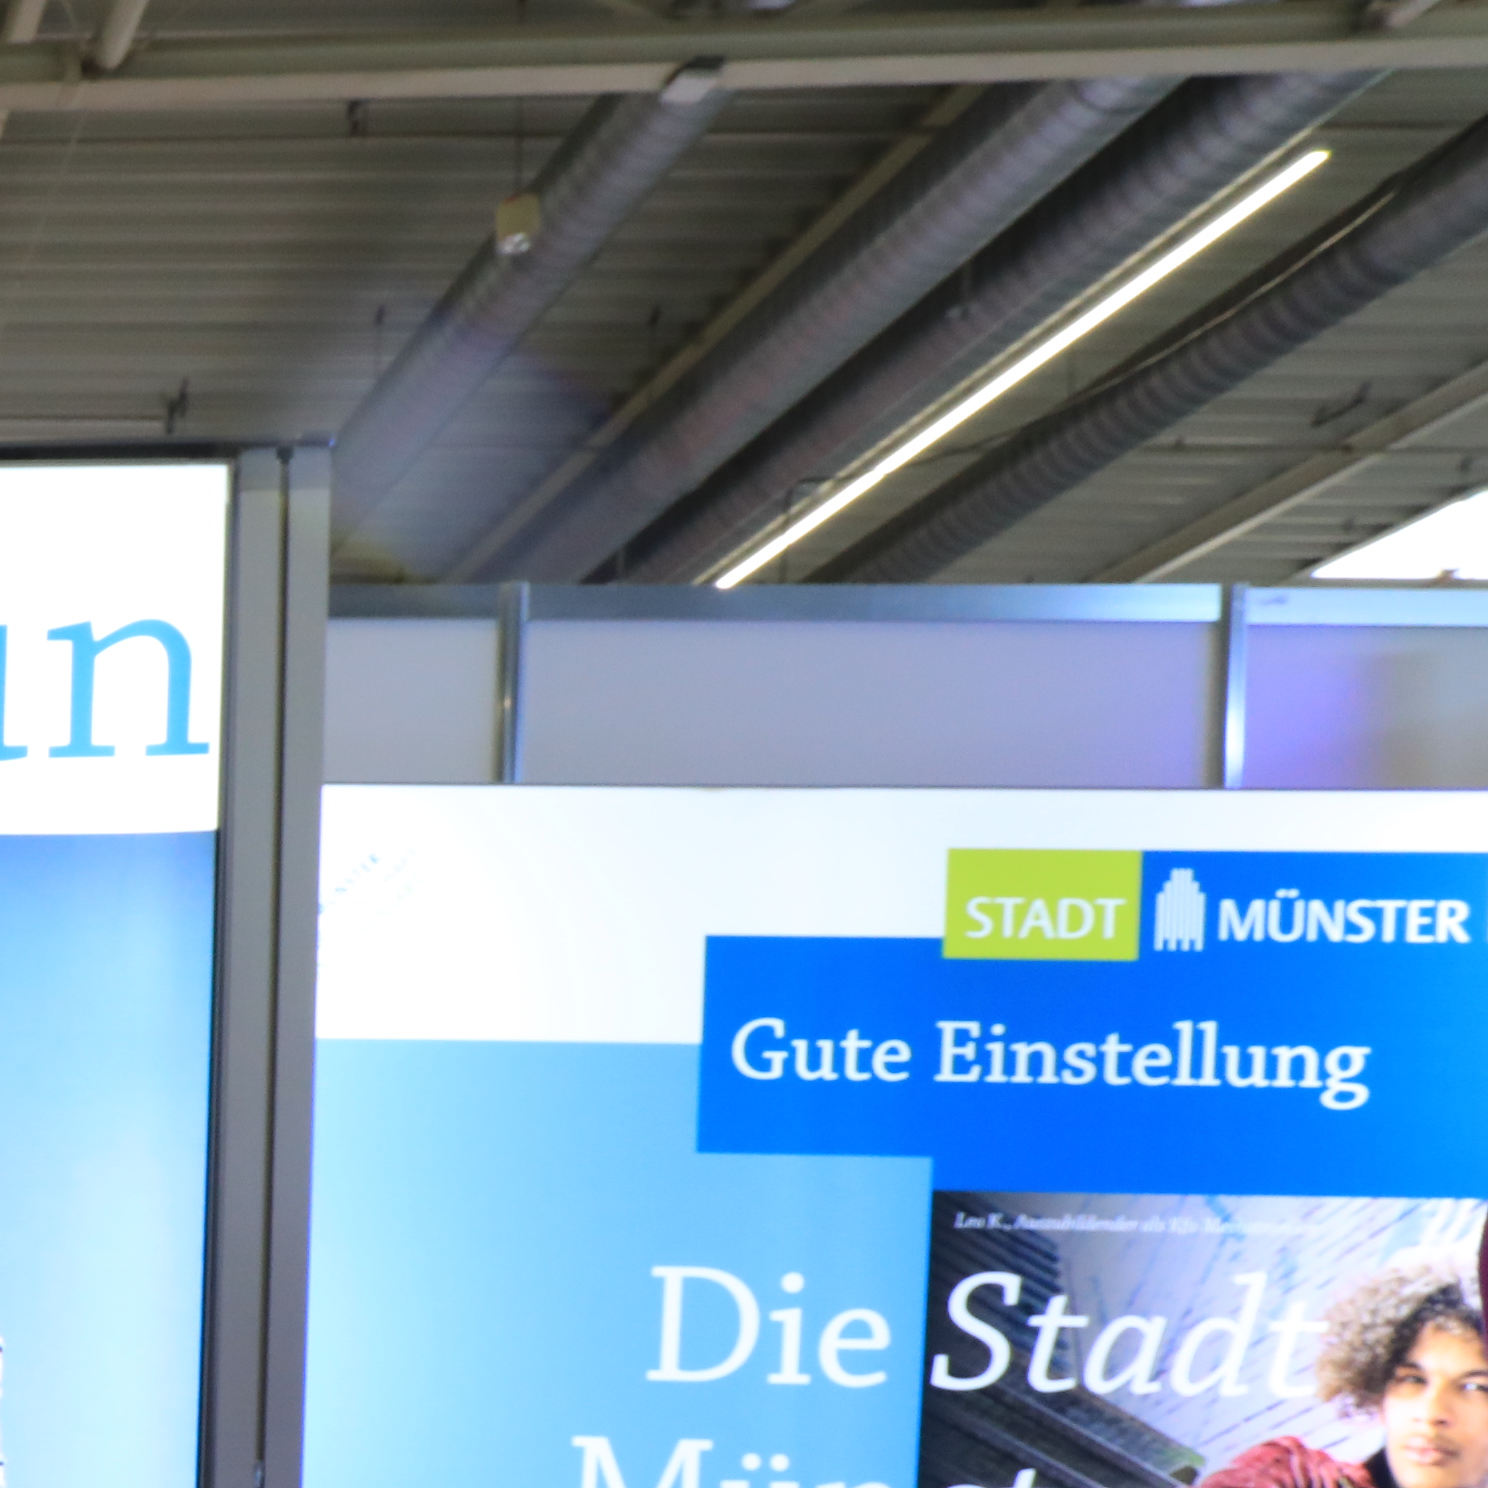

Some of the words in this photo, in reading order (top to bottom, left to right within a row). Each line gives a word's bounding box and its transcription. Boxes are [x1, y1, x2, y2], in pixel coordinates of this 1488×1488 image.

[965, 897, 1127, 940] STADT
[1218, 888, 1470, 943] MÜNSTER
[731, 1017, 912, 1082] Gute
[935, 1021, 1372, 1111] Einstellung
[645, 1264, 891, 1389] Die
[929, 1270, 1328, 1398] Stadt
